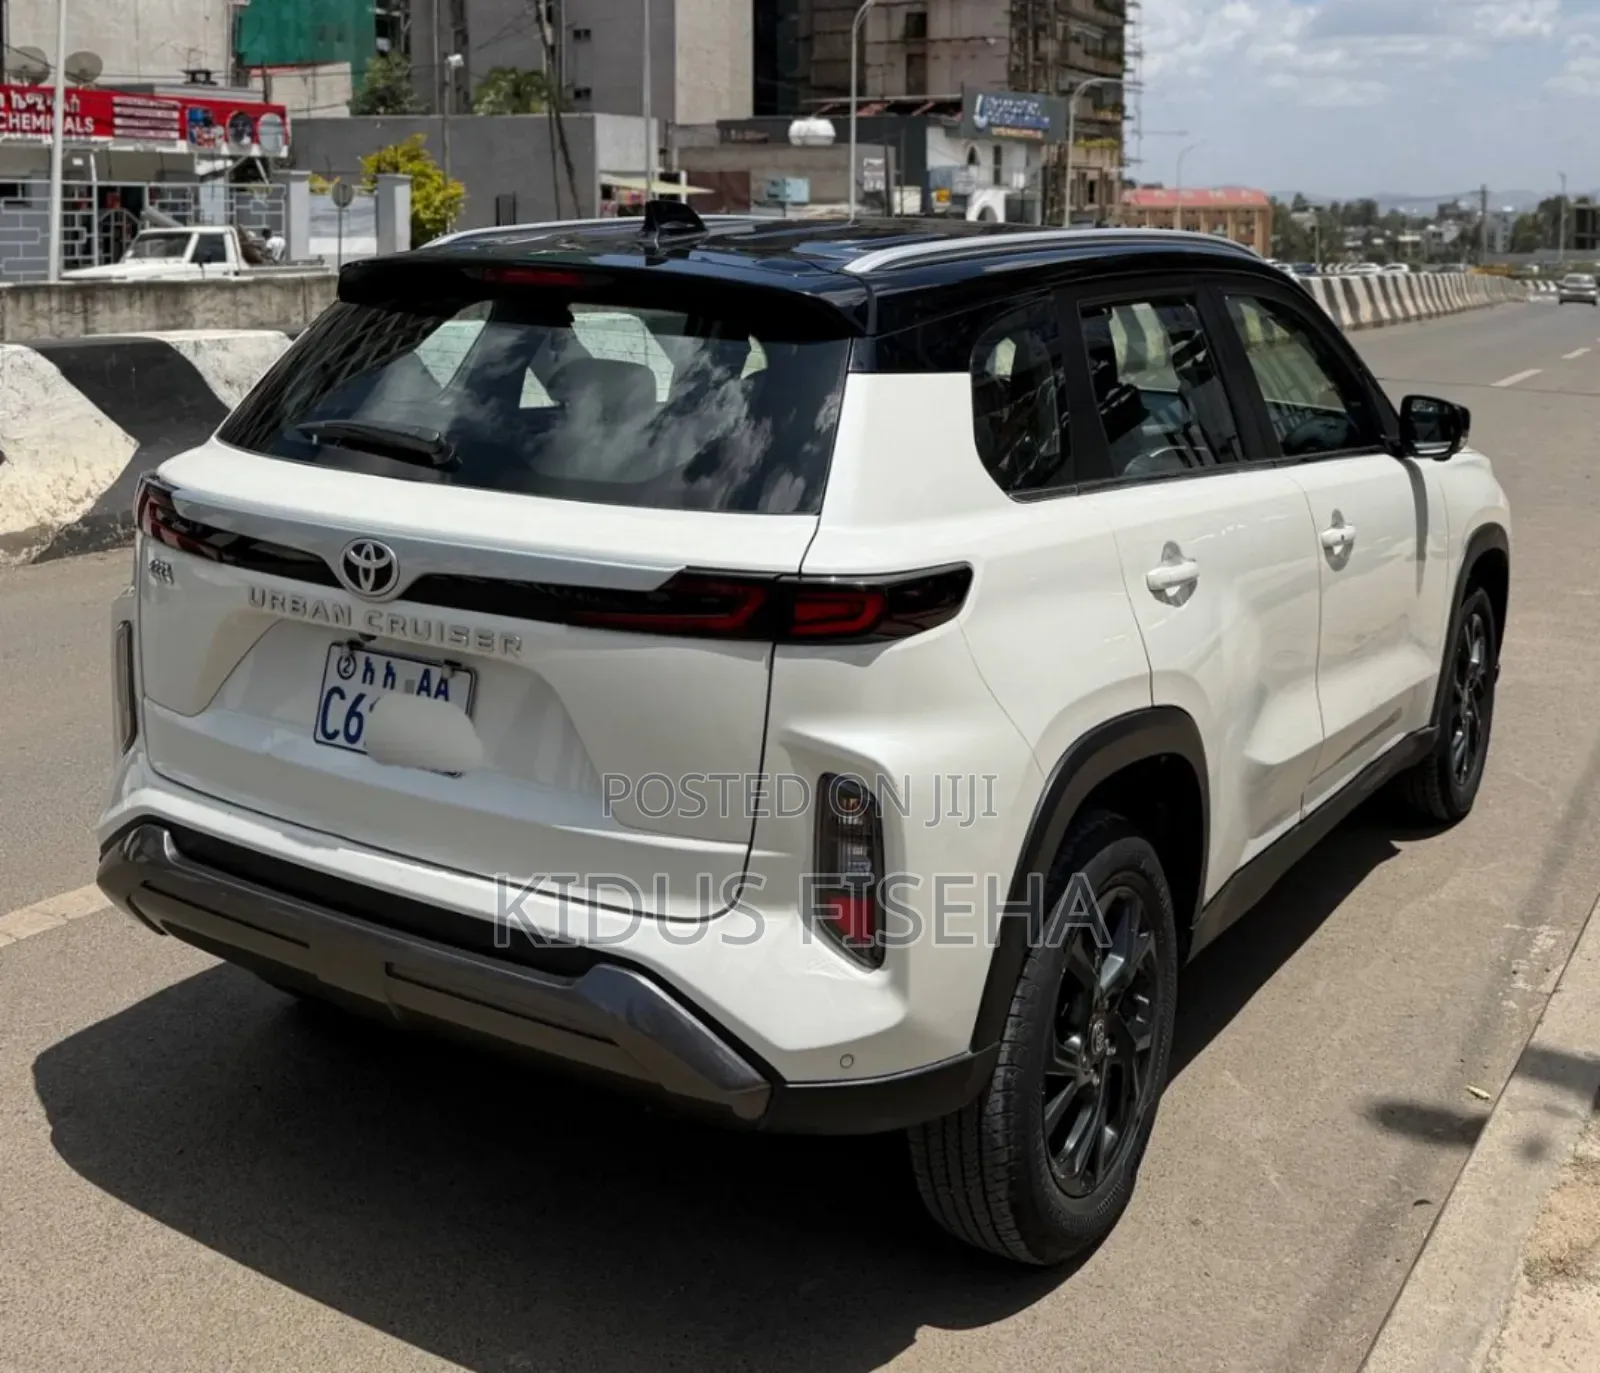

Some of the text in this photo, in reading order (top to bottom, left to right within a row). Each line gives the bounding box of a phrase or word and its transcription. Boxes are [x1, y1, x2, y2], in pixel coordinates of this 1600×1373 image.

[0, 112, 95, 133] CHEMIALS
[248, 586, 524, 658] URBAN CRUISER
[416, 668, 450, 702] AA
